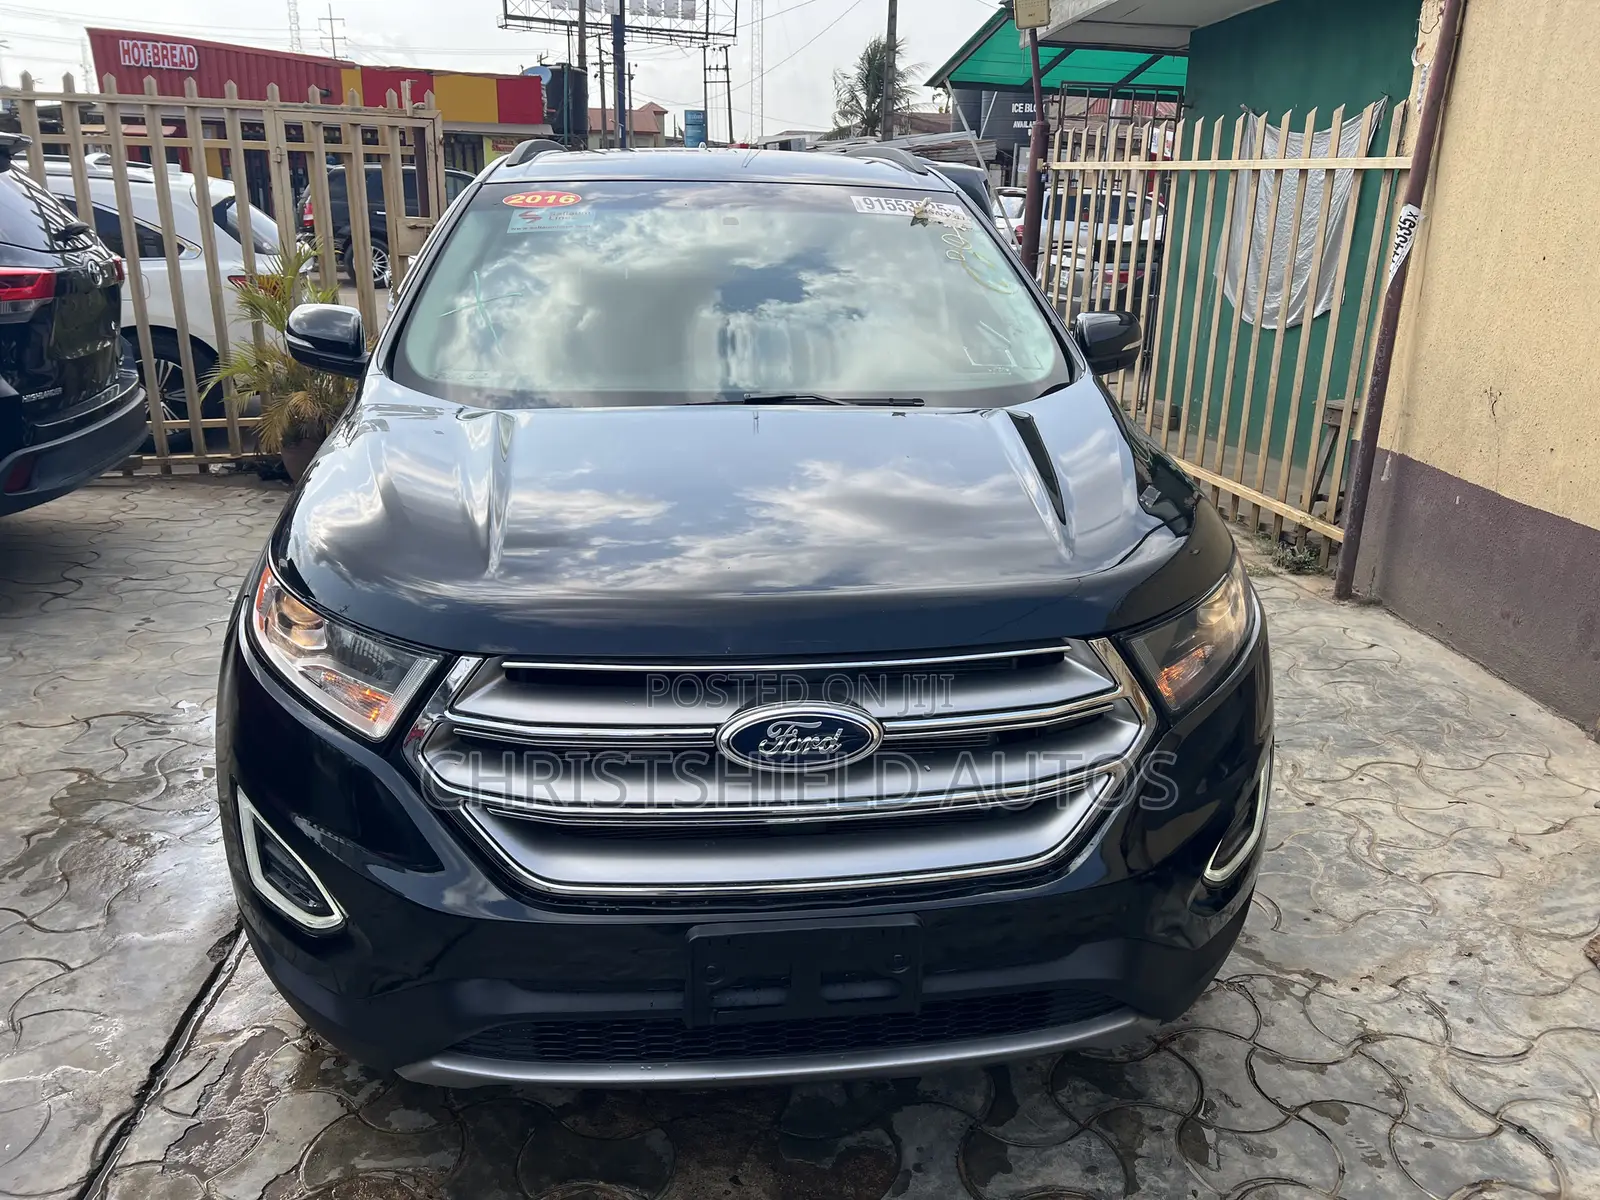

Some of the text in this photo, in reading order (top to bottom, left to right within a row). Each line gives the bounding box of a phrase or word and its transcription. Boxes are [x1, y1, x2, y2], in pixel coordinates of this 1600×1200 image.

[1011, 103, 1024, 113] ICE
[507, 194, 576, 204] 2016
[758, 720, 844, 756] Ford
